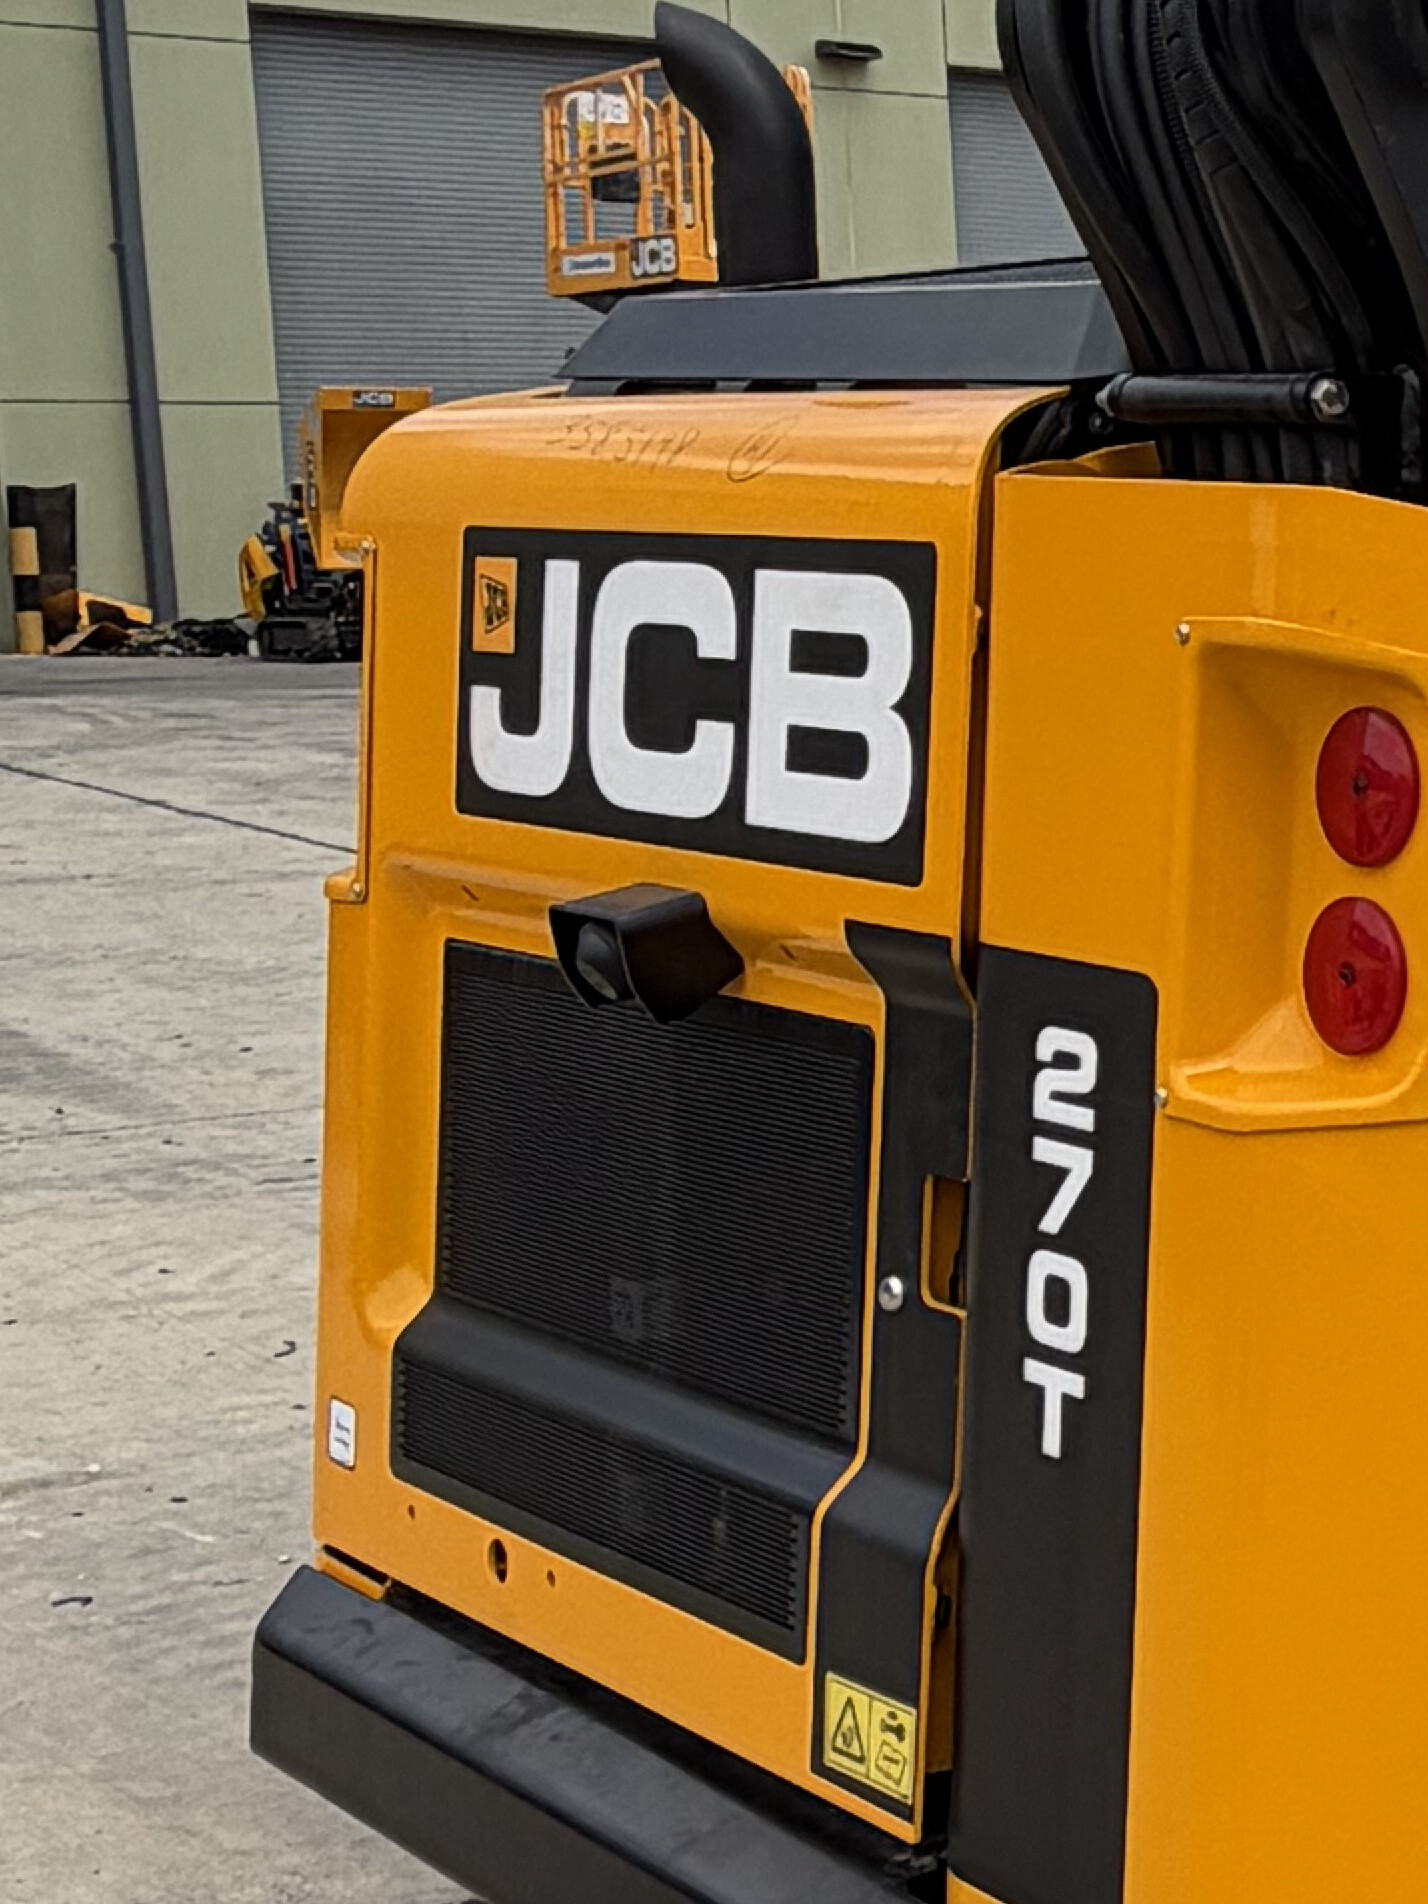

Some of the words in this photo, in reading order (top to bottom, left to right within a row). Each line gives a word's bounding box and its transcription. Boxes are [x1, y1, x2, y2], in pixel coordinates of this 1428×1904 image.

[631, 238, 676, 277] JCB
[470, 558, 913, 844] JCB
[1023, 1025, 1098, 1459] 270T
